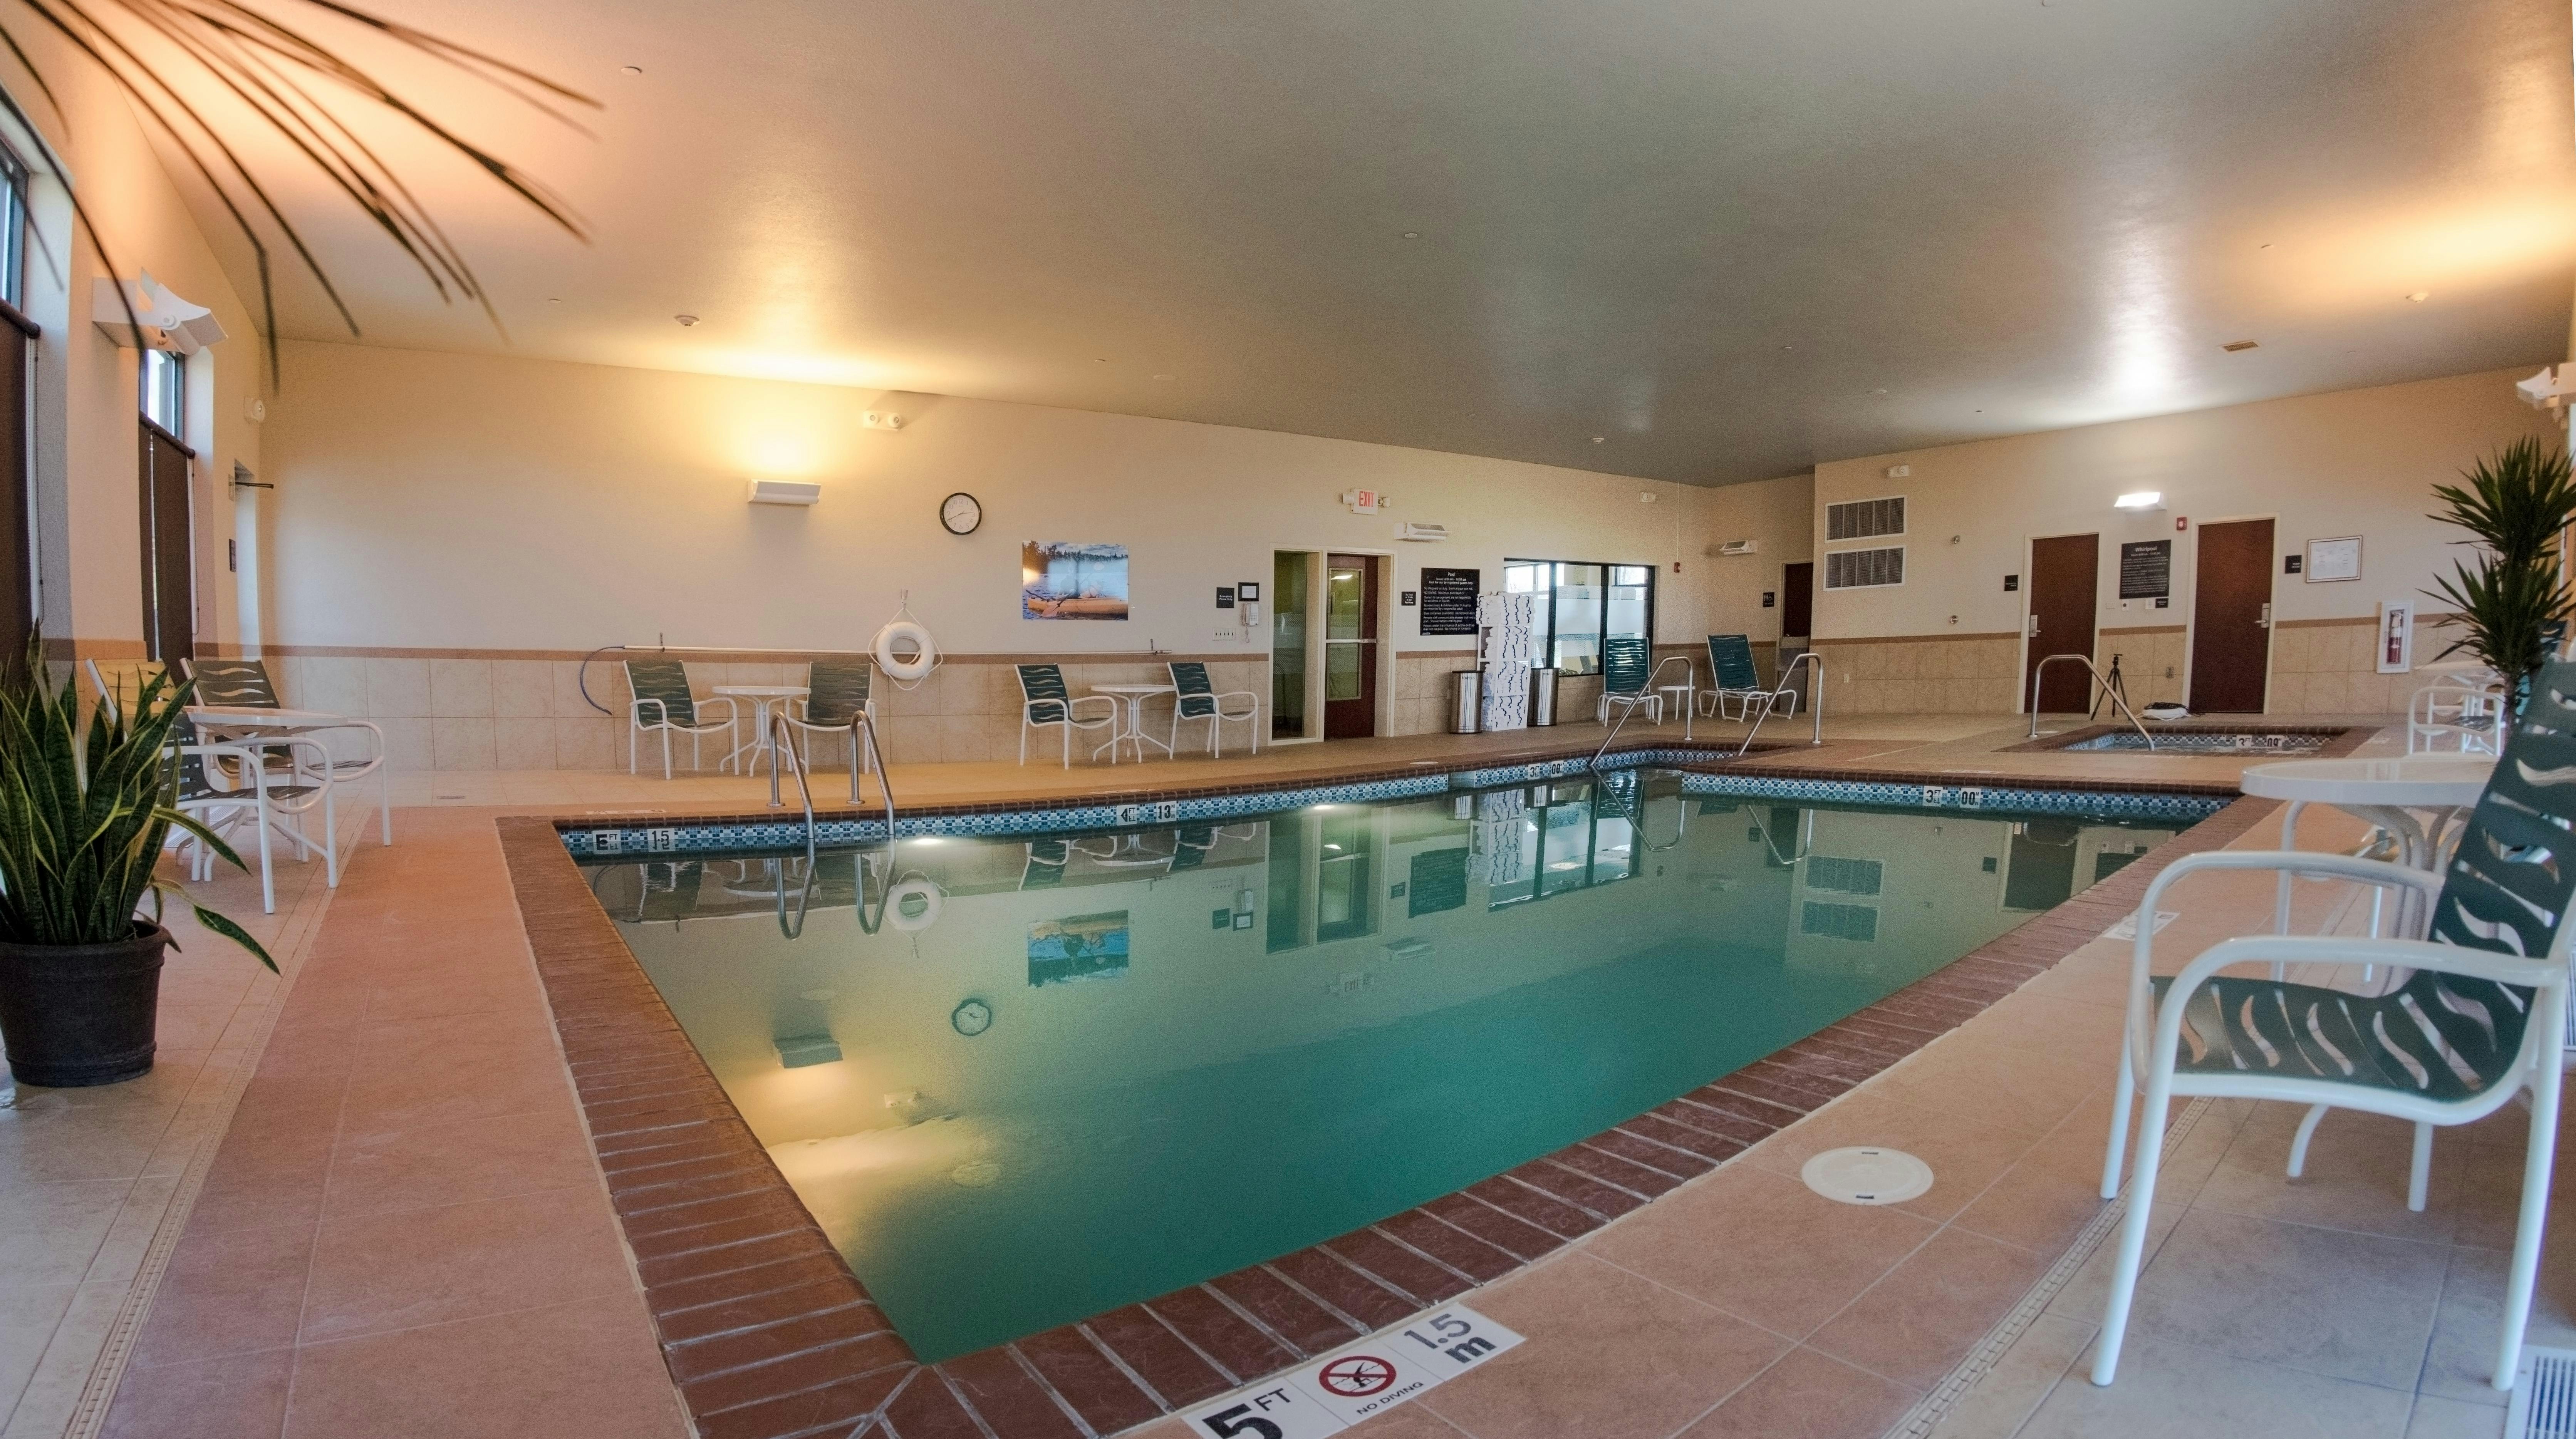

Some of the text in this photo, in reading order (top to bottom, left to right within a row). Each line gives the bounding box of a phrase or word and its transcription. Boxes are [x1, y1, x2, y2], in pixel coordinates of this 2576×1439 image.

[1359, 491, 1375, 507] EXIT
[1530, 767, 1535, 777] 3
[1926, 789, 1934, 803] 3
[1404, 1313, 1471, 1349] 1.5
[1444, 1337, 1497, 1364] m
[1356, 1382, 1424, 1414] NO DIVING
[1202, 1388, 1291, 1439] 5 FT
